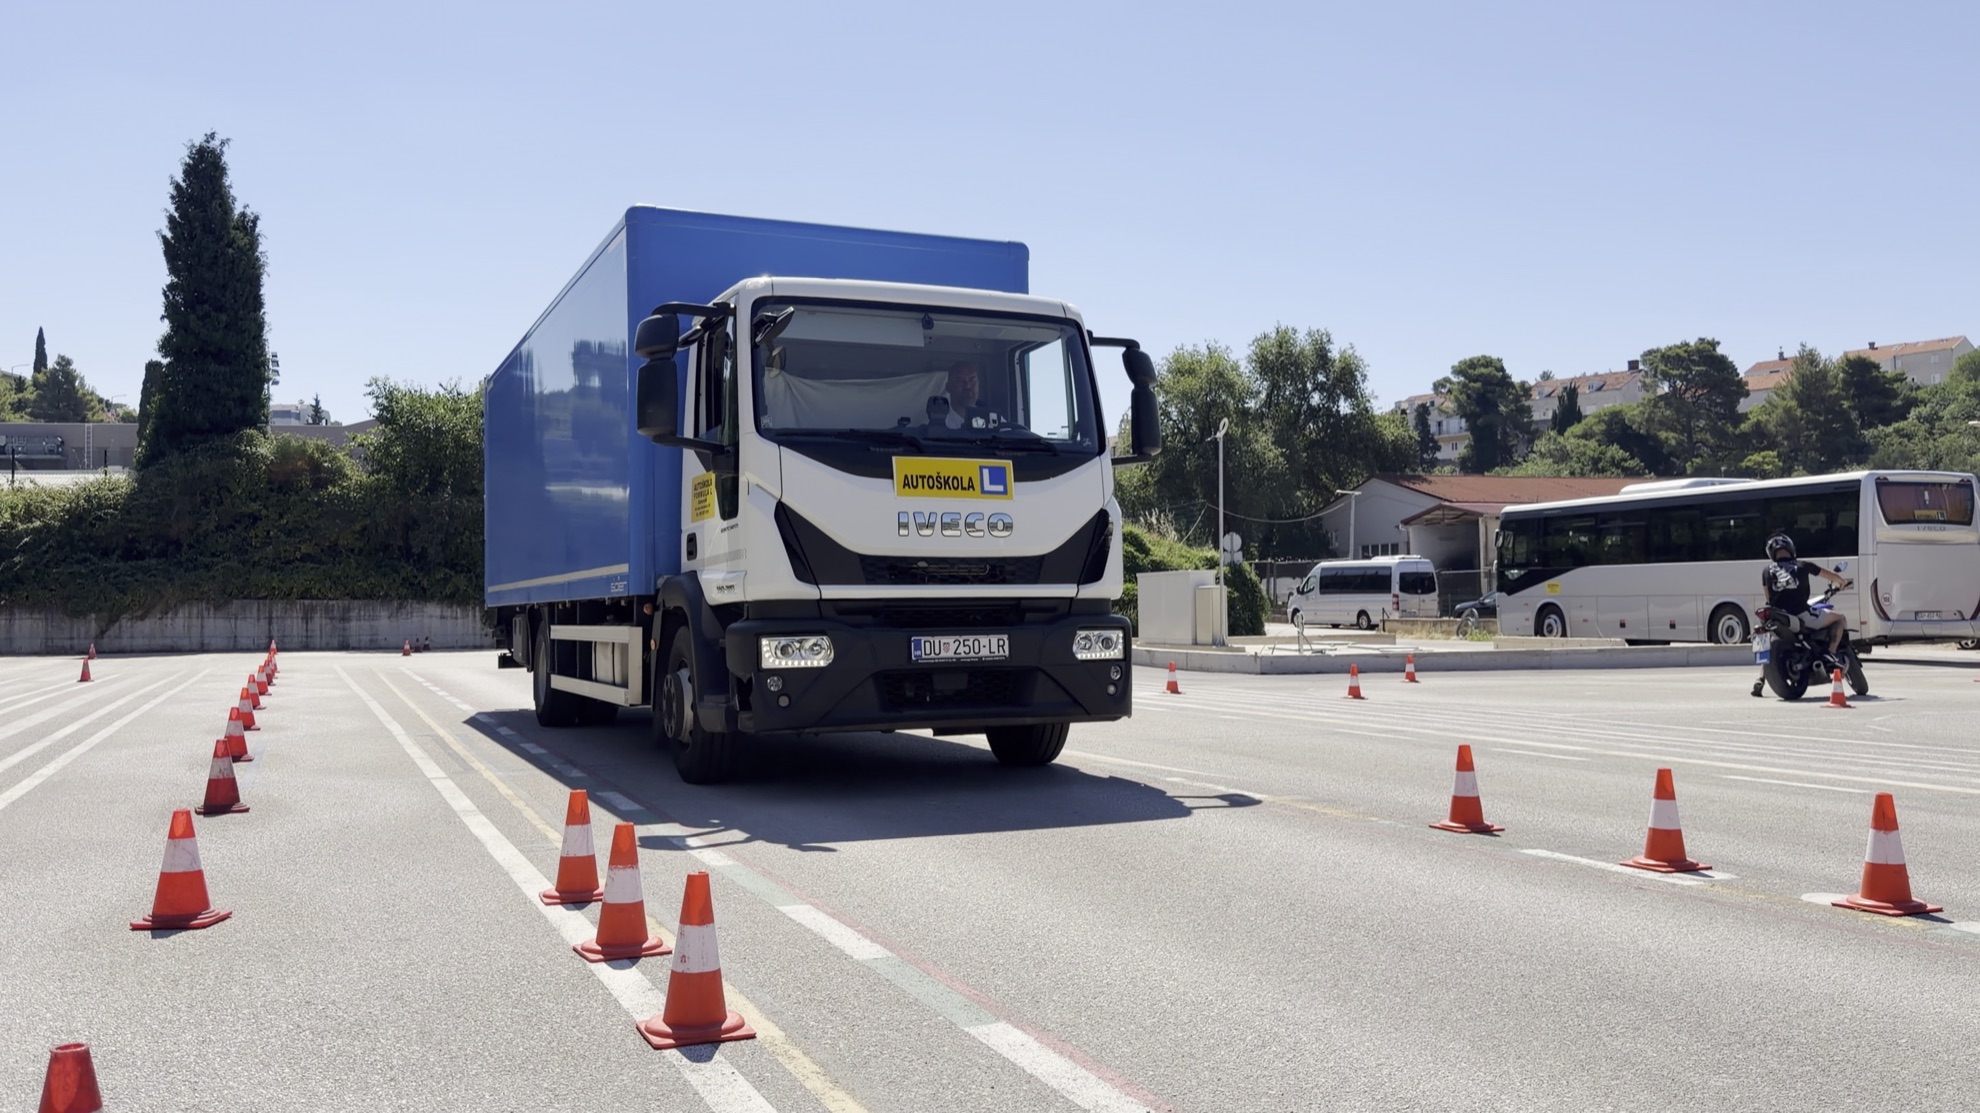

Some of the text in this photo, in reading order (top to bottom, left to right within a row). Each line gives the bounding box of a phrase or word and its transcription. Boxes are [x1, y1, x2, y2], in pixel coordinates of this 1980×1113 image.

[902, 468, 1004, 492] AUTOŠKOLA L
[898, 511, 1014, 538] IVECO
[923, 640, 942, 657] DU
[952, 638, 1006, 656] 250-LR
